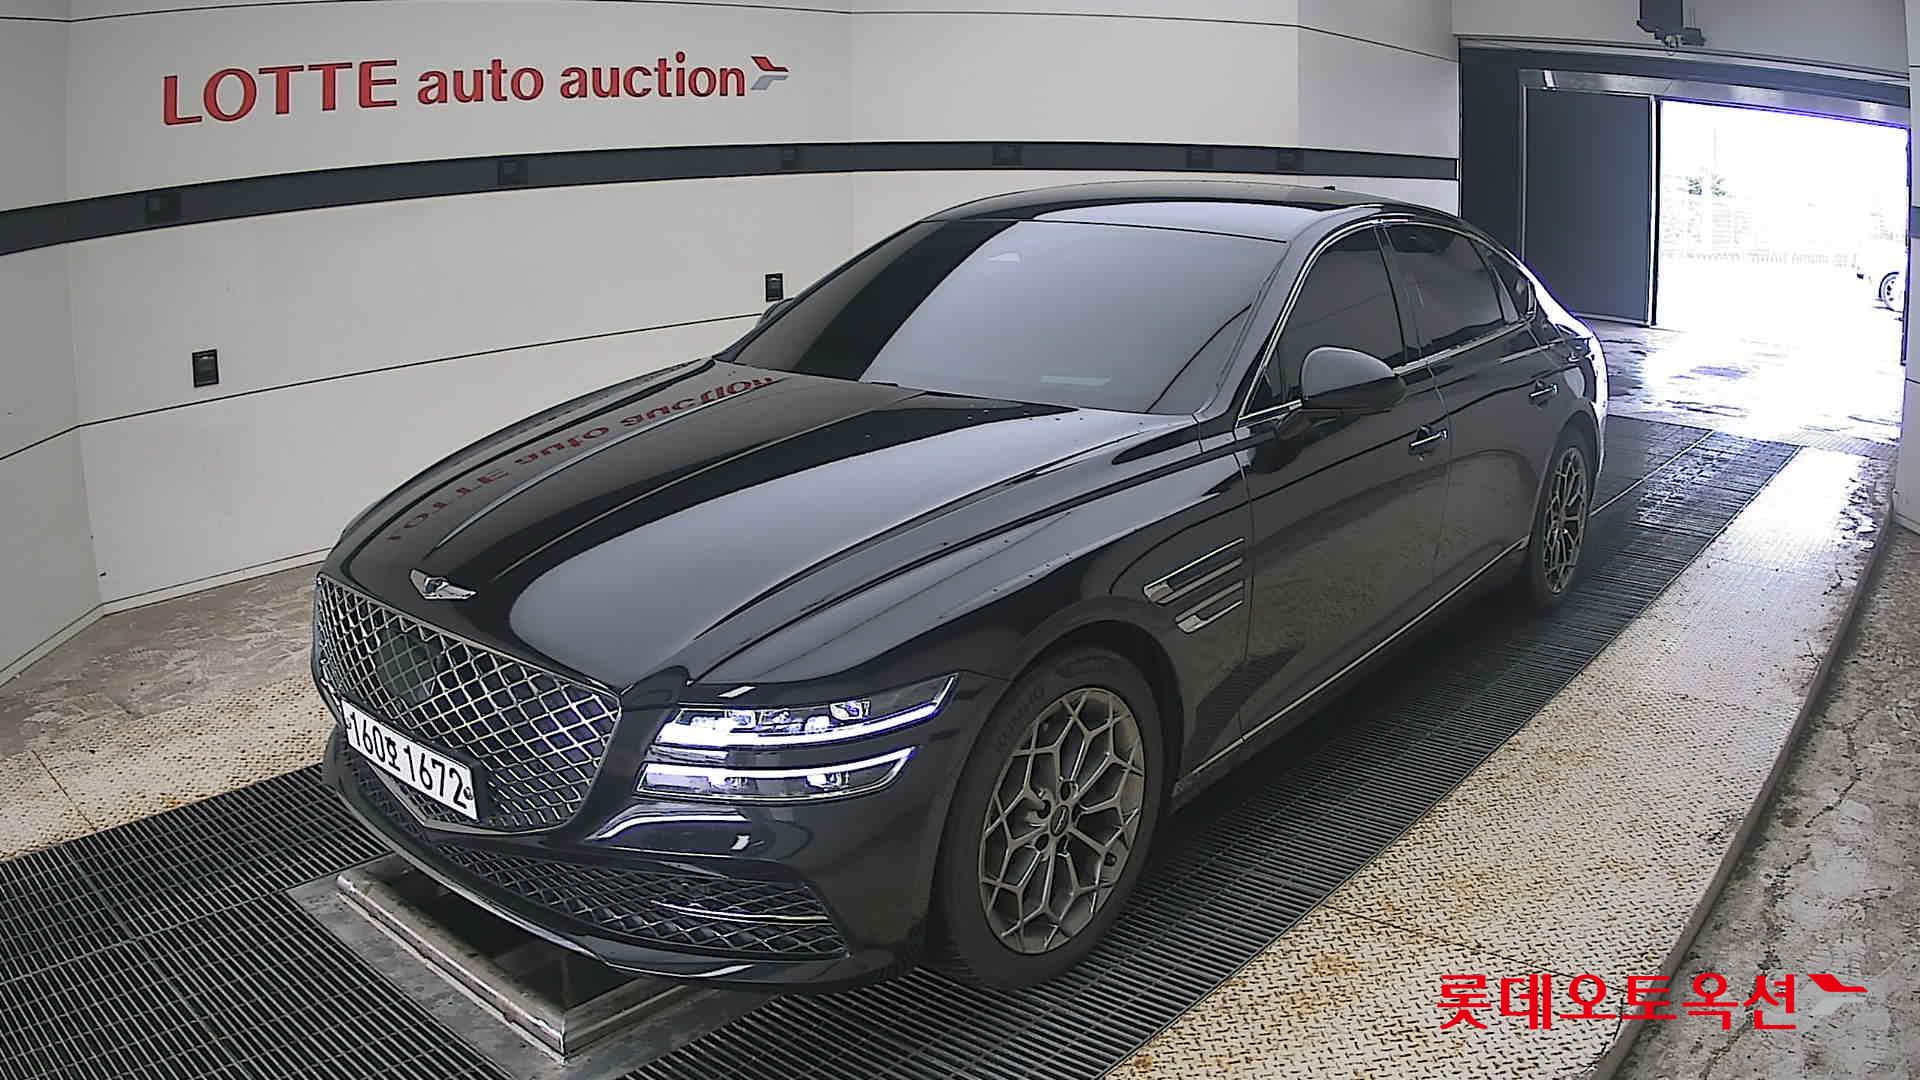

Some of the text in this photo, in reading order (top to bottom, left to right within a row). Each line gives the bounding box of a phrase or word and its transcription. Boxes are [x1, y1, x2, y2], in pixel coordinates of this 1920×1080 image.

[163, 51, 747, 126] LOTTE auto auction
